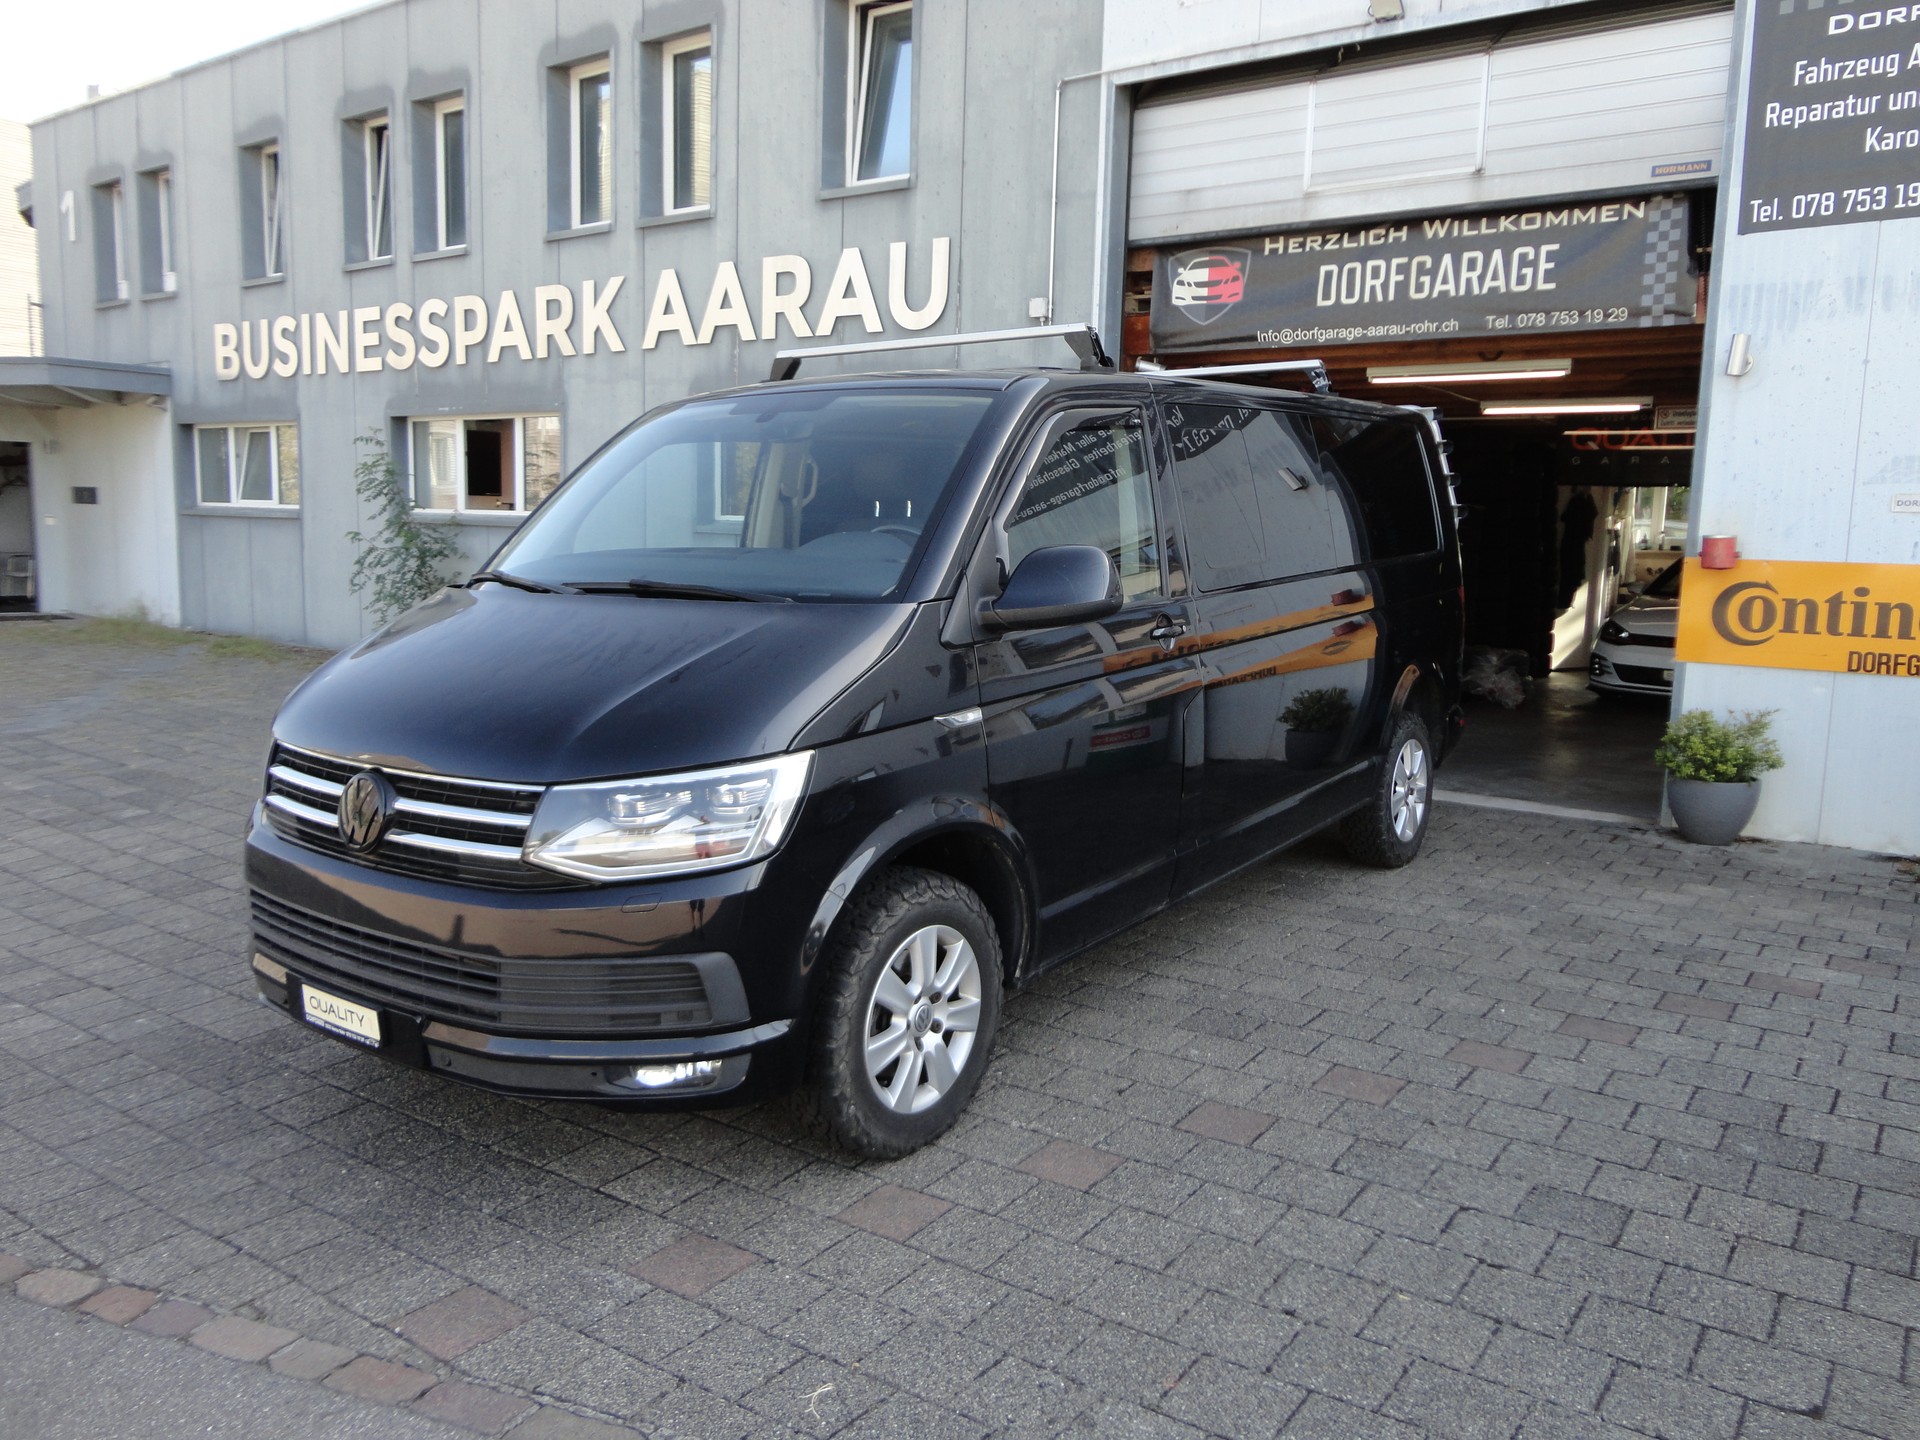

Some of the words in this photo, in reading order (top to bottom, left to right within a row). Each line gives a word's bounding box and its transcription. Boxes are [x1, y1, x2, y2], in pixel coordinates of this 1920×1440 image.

[1793, 53, 1900, 87] Fahrzeug
[1765, 94, 1881, 129] Reparatur
[1888, 90, 1920, 111] un
[1864, 126, 1919, 153] Karo
[60, 190, 76, 241] 1
[1750, 197, 1783, 223] Tel.
[1791, 191, 1836, 219] 078
[1843, 185, 1888, 214] 753
[1894, 182, 1920, 209] 19
[1263, 225, 1408, 256] HERZLICH
[1423, 201, 1646, 240] WILLKOMMEN
[1316, 243, 1560, 307] DORFGARAGE
[213, 275, 626, 382] BUSINESSPARK
[642, 236, 950, 350] AARAU
[1486, 314, 1512, 330] Tel.
[1517, 312, 1546, 328] 078
[1551, 310, 1579, 326] 753
[1584, 308, 1604, 324] 19
[1608, 306, 1629, 322] 29
[1896, 499, 1920, 507] DOR
[1711, 579, 1920, 647] Contin
[1847, 650, 1920, 676] DORFG
[309, 995, 365, 1028] QUALITY
